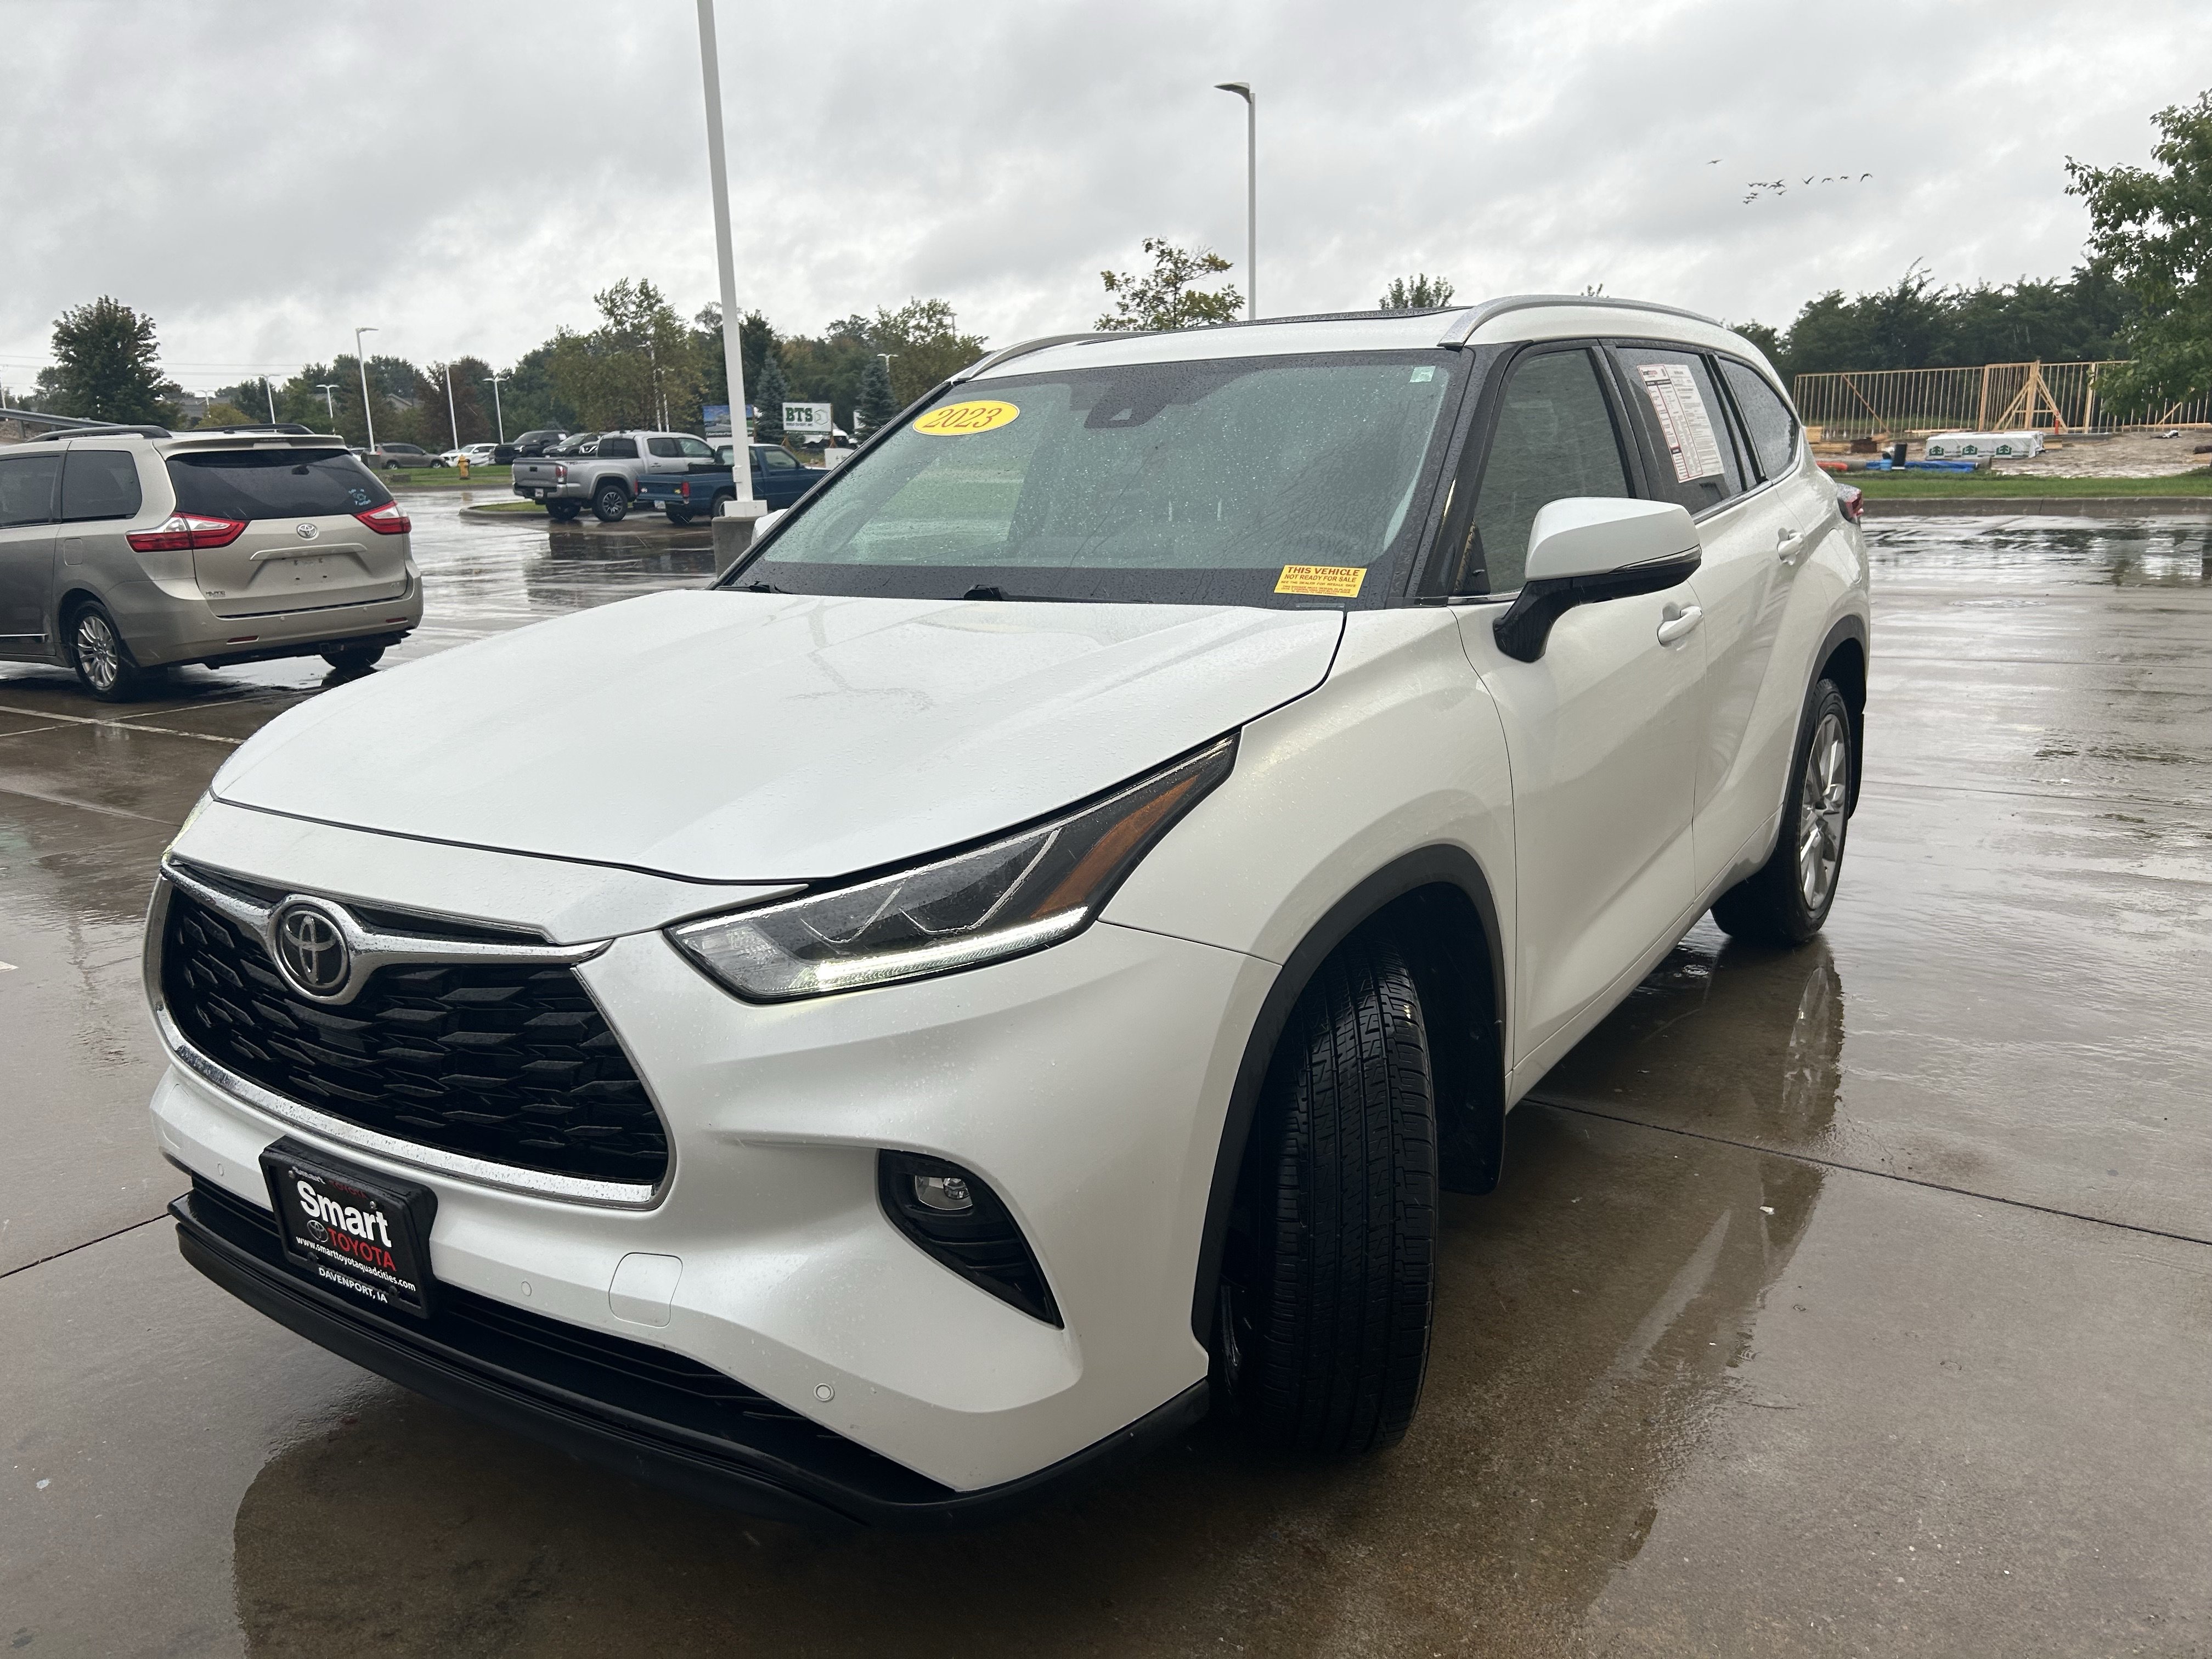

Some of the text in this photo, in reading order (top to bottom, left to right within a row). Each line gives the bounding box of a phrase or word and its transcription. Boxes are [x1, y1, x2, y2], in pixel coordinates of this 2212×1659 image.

[786, 408, 813, 422] BTS
[922, 408, 1003, 428] 2023
[1314, 568, 1361, 577] VEHICLE
[297, 1180, 392, 1248] Smart
[296, 1236, 416, 1291] www.smarttoyotaquadcities.com
[328, 1228, 396, 1271] TOYOTA
[319, 1267, 388, 1304] DAVENPORT, IA
